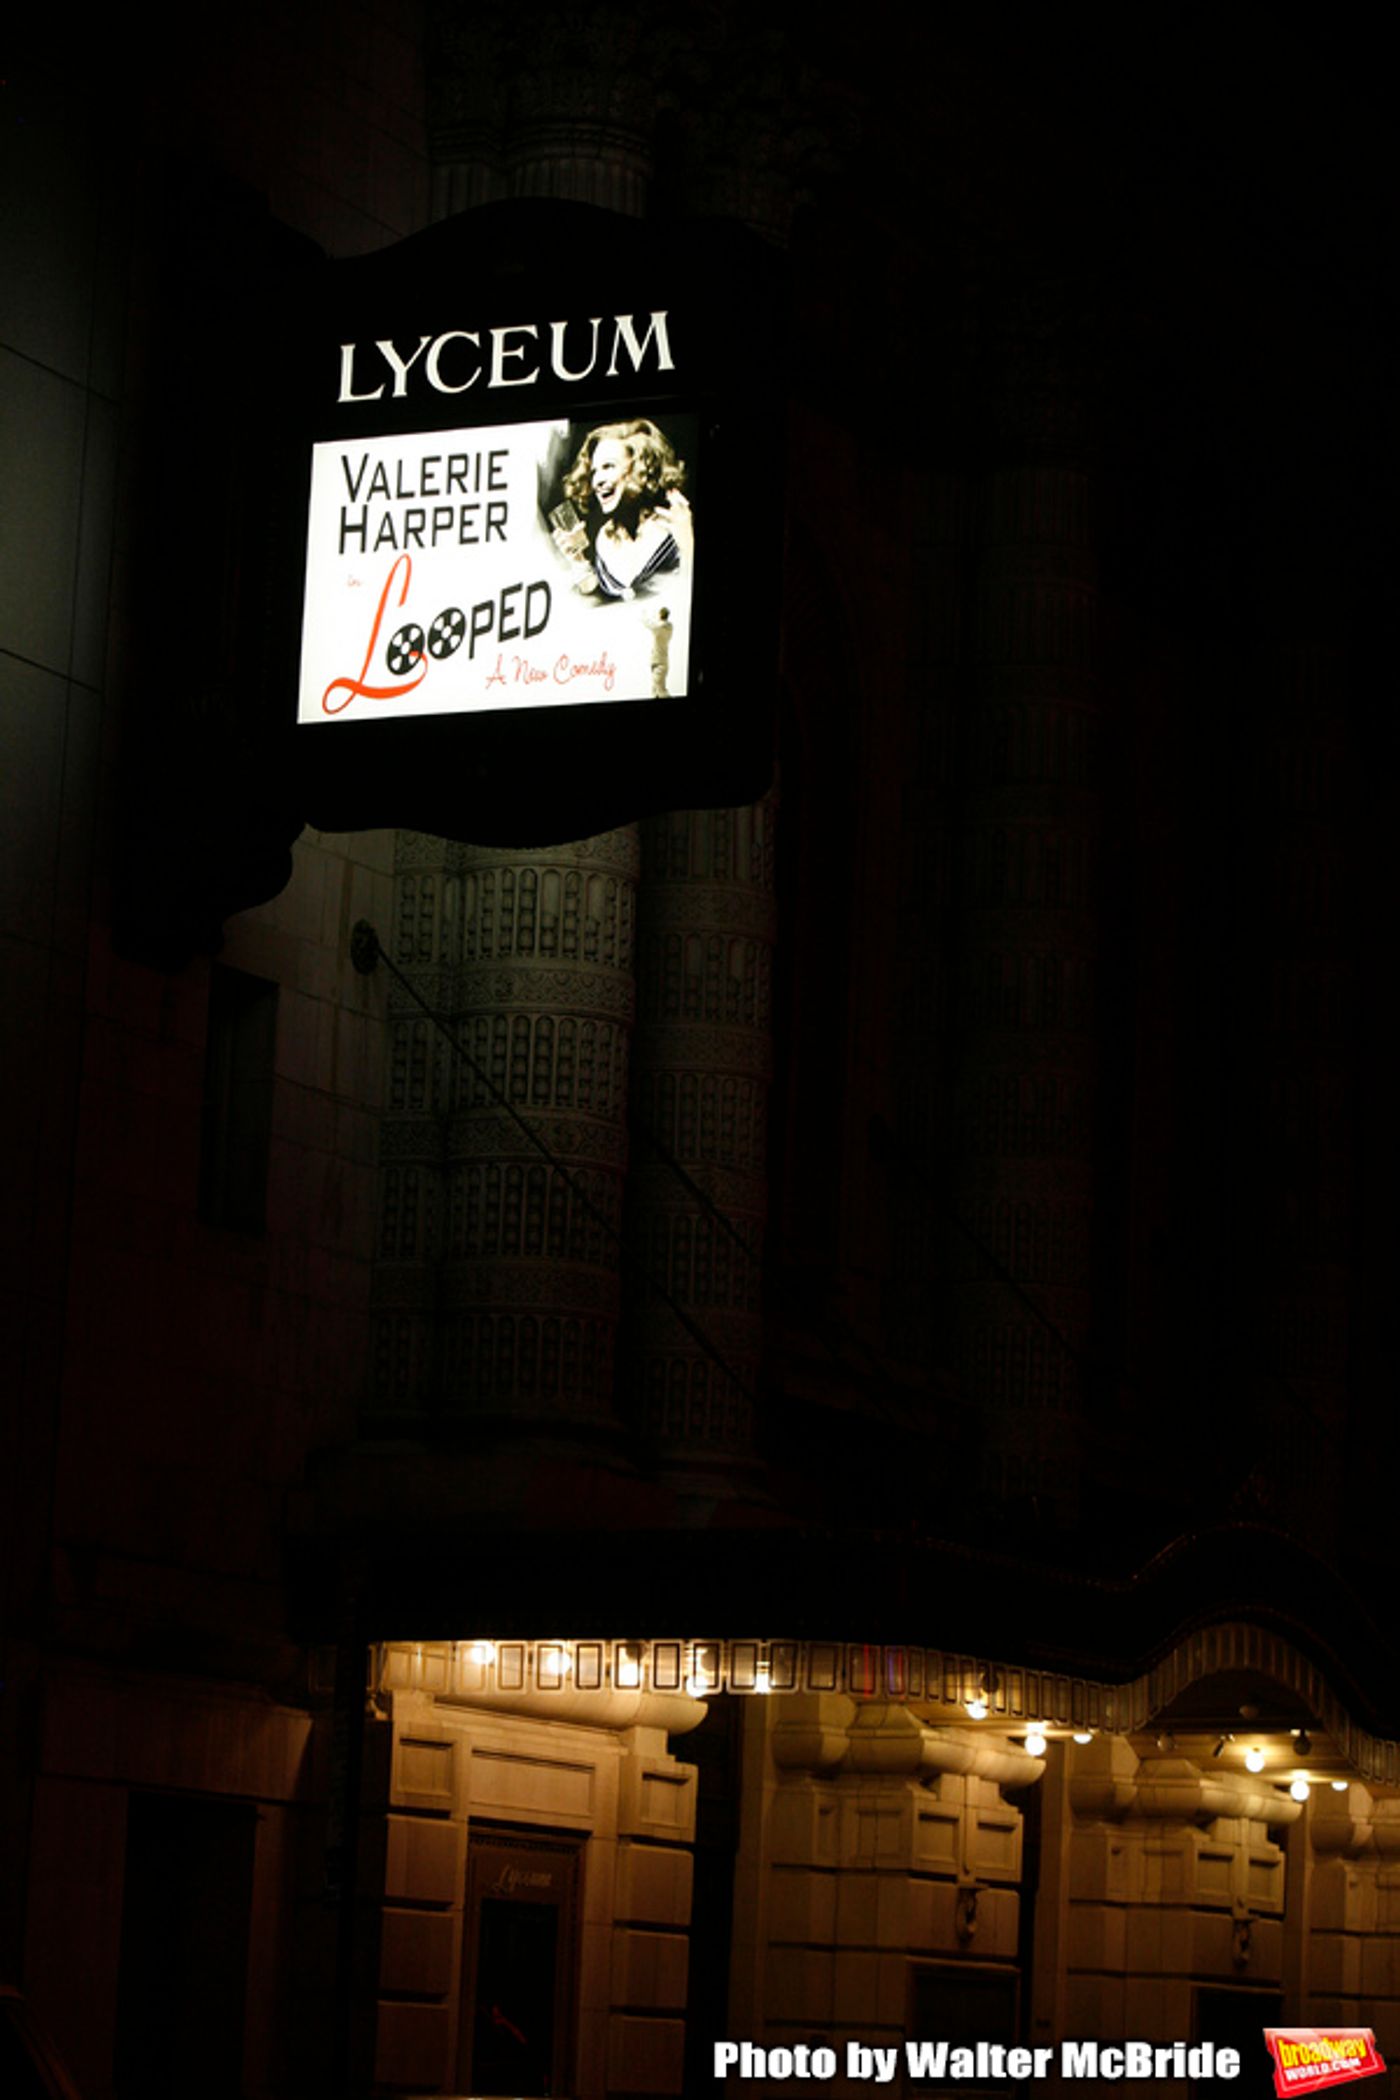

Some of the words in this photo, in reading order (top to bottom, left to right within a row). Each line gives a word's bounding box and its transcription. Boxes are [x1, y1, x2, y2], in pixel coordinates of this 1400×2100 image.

[337, 310, 676, 403] LYCEUM
[340, 449, 510, 503] VALERIE
[338, 501, 509, 555] HARPER
[321, 553, 552, 716] LOOPED
[484, 655, 507, 690] A
[511, 655, 549, 684] New
[553, 651, 618, 691] Comedy
